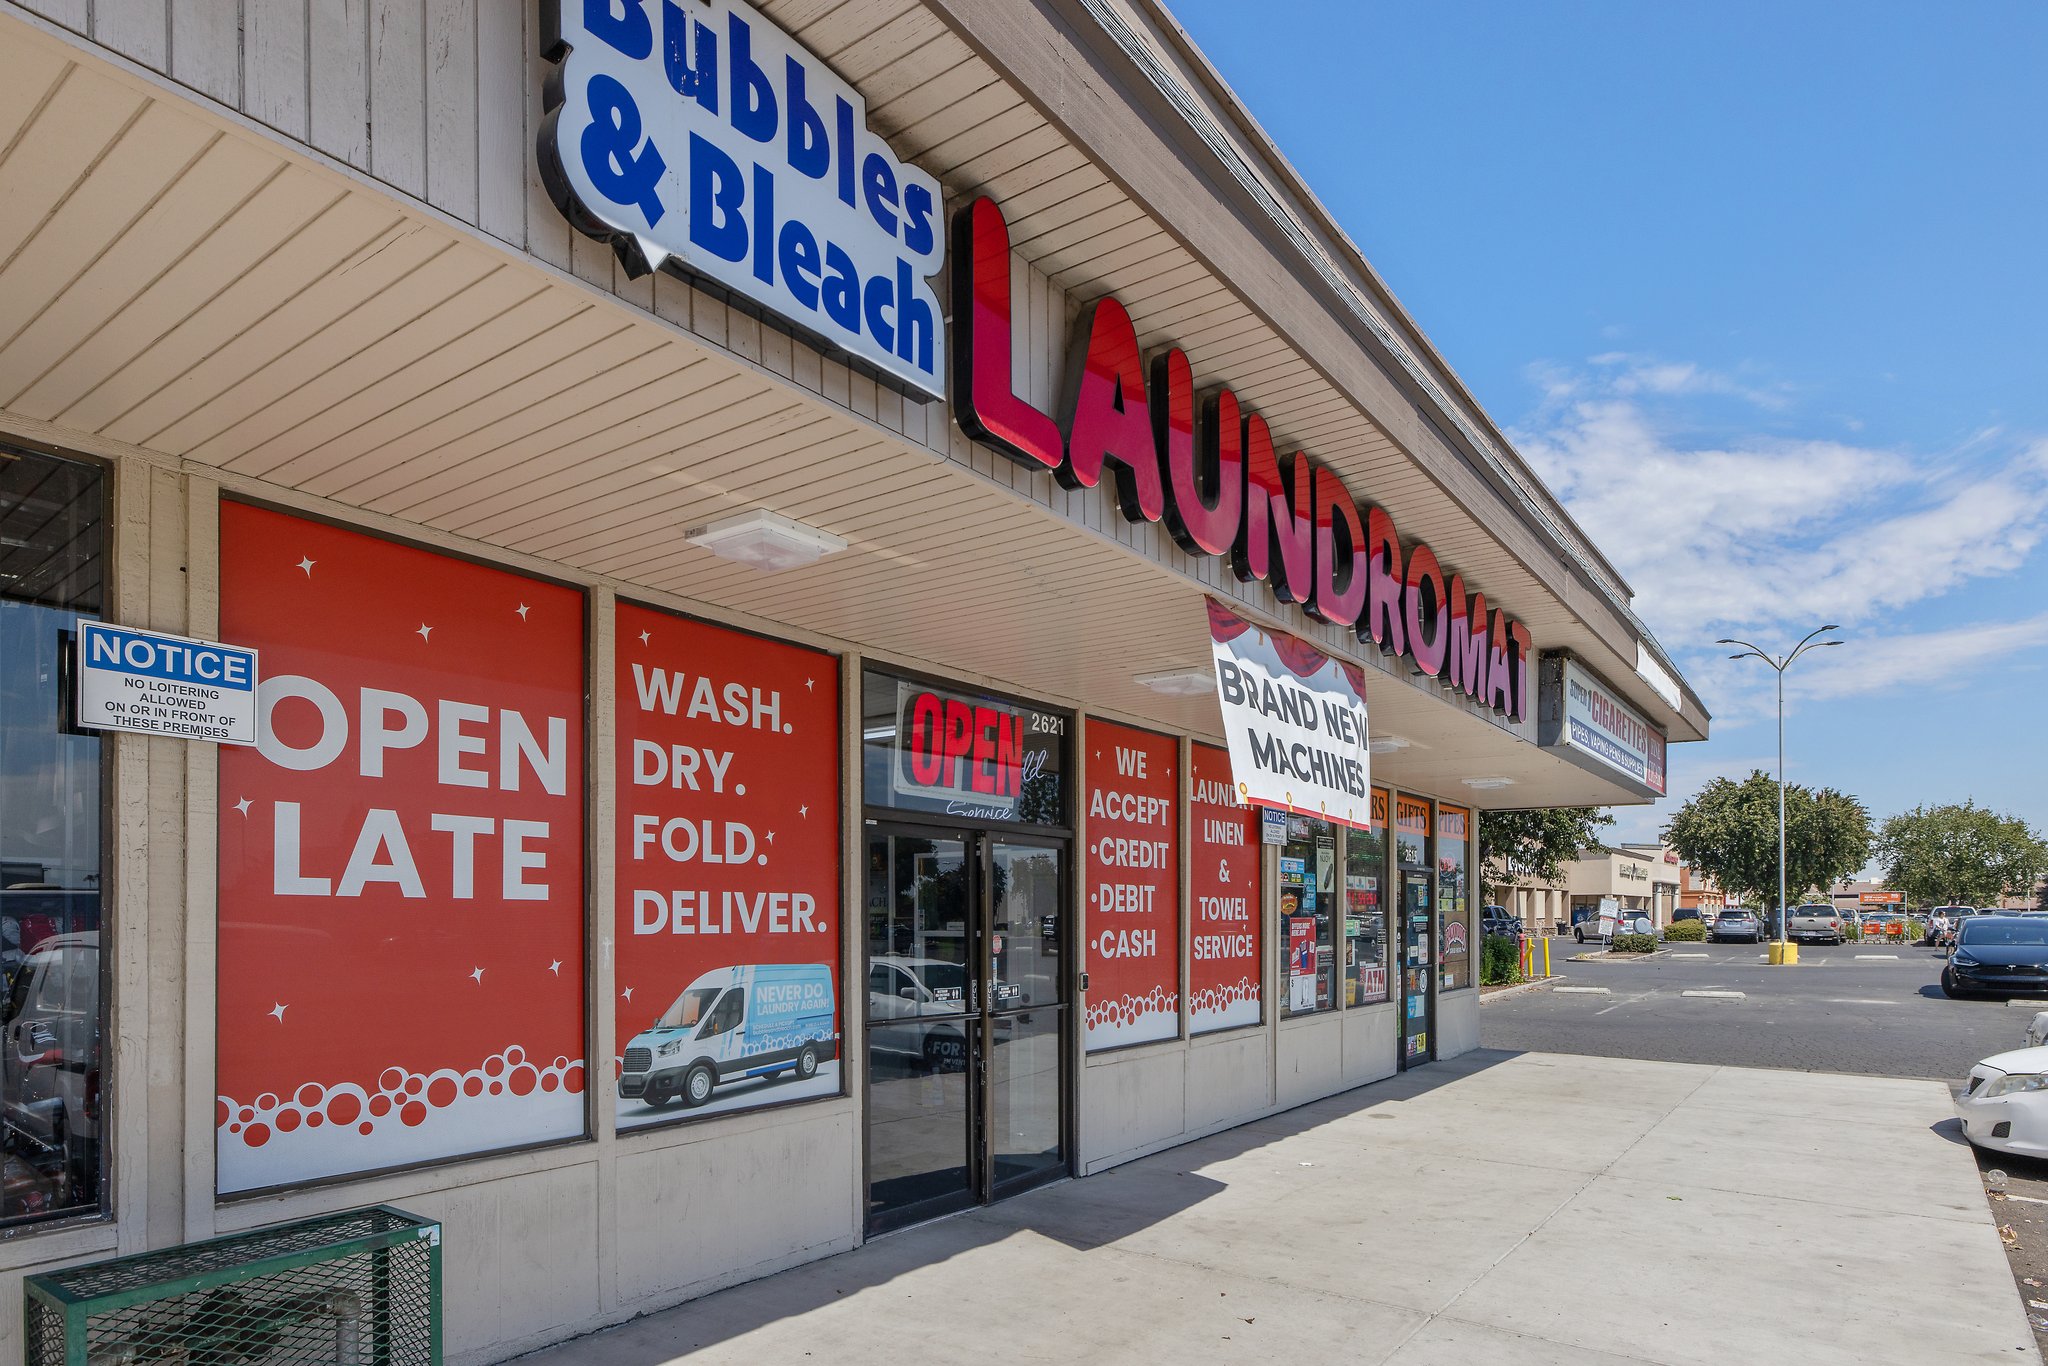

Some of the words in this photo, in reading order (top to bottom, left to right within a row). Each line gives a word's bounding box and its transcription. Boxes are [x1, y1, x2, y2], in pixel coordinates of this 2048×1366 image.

[581, 74, 666, 229] &
[690, 131, 934, 376] Bleach
[965, 196, 1531, 724] LAUNDROMAT
[93, 633, 247, 684] NOTICE
[124, 677, 144, 689] NO
[149, 681, 219, 700] LOITERING
[140, 693, 206, 710] ALLOWED
[632, 663, 793, 735] WASH.
[1218, 658, 1318, 731] BRAND
[1322, 699, 1368, 751] NEW
[105, 701, 125, 712] ON
[130, 704, 150, 715] OR
[154, 707, 167, 718] IN
[171, 709, 215, 724] FRONT
[219, 716, 236, 727] OF
[113, 715, 159, 730] THESE
[163, 721, 229, 738] PREMISES
[1032, 713, 1064, 735] 2621
[1591, 690, 1647, 755] CIGARETTES
[257, 675, 567, 797] OPEN
[911, 692, 1024, 797] OPEN
[633, 739, 746, 796] DRY.
[1115, 746, 1147, 779] WE
[1248, 728, 1366, 799] MACHINES
[1090, 789, 1169, 826] ACCEPT
[1190, 776, 1254, 811] LAUND
[1264, 810, 1285, 823] NOTICE
[1397, 802, 1427, 829] GIFTS
[1439, 811, 1464, 835] PIPES
[633, 814, 768, 866] FOLD.
[1204, 819, 1244, 846] LINEN
[274, 801, 549, 900] LATE
[1219, 859, 1231, 883] &
[633, 889, 827, 935] DELIVER.
[1199, 896, 1249, 921] TOWEL
[1194, 935, 1253, 960] SERVICE
[757, 985, 802, 1003] NEVER
[804, 983, 823, 998] DO
[1366, 970, 1385, 993] ATM
[757, 1001, 800, 1016] LAUNDRY
[801, 998, 830, 1010] AGAIN!
